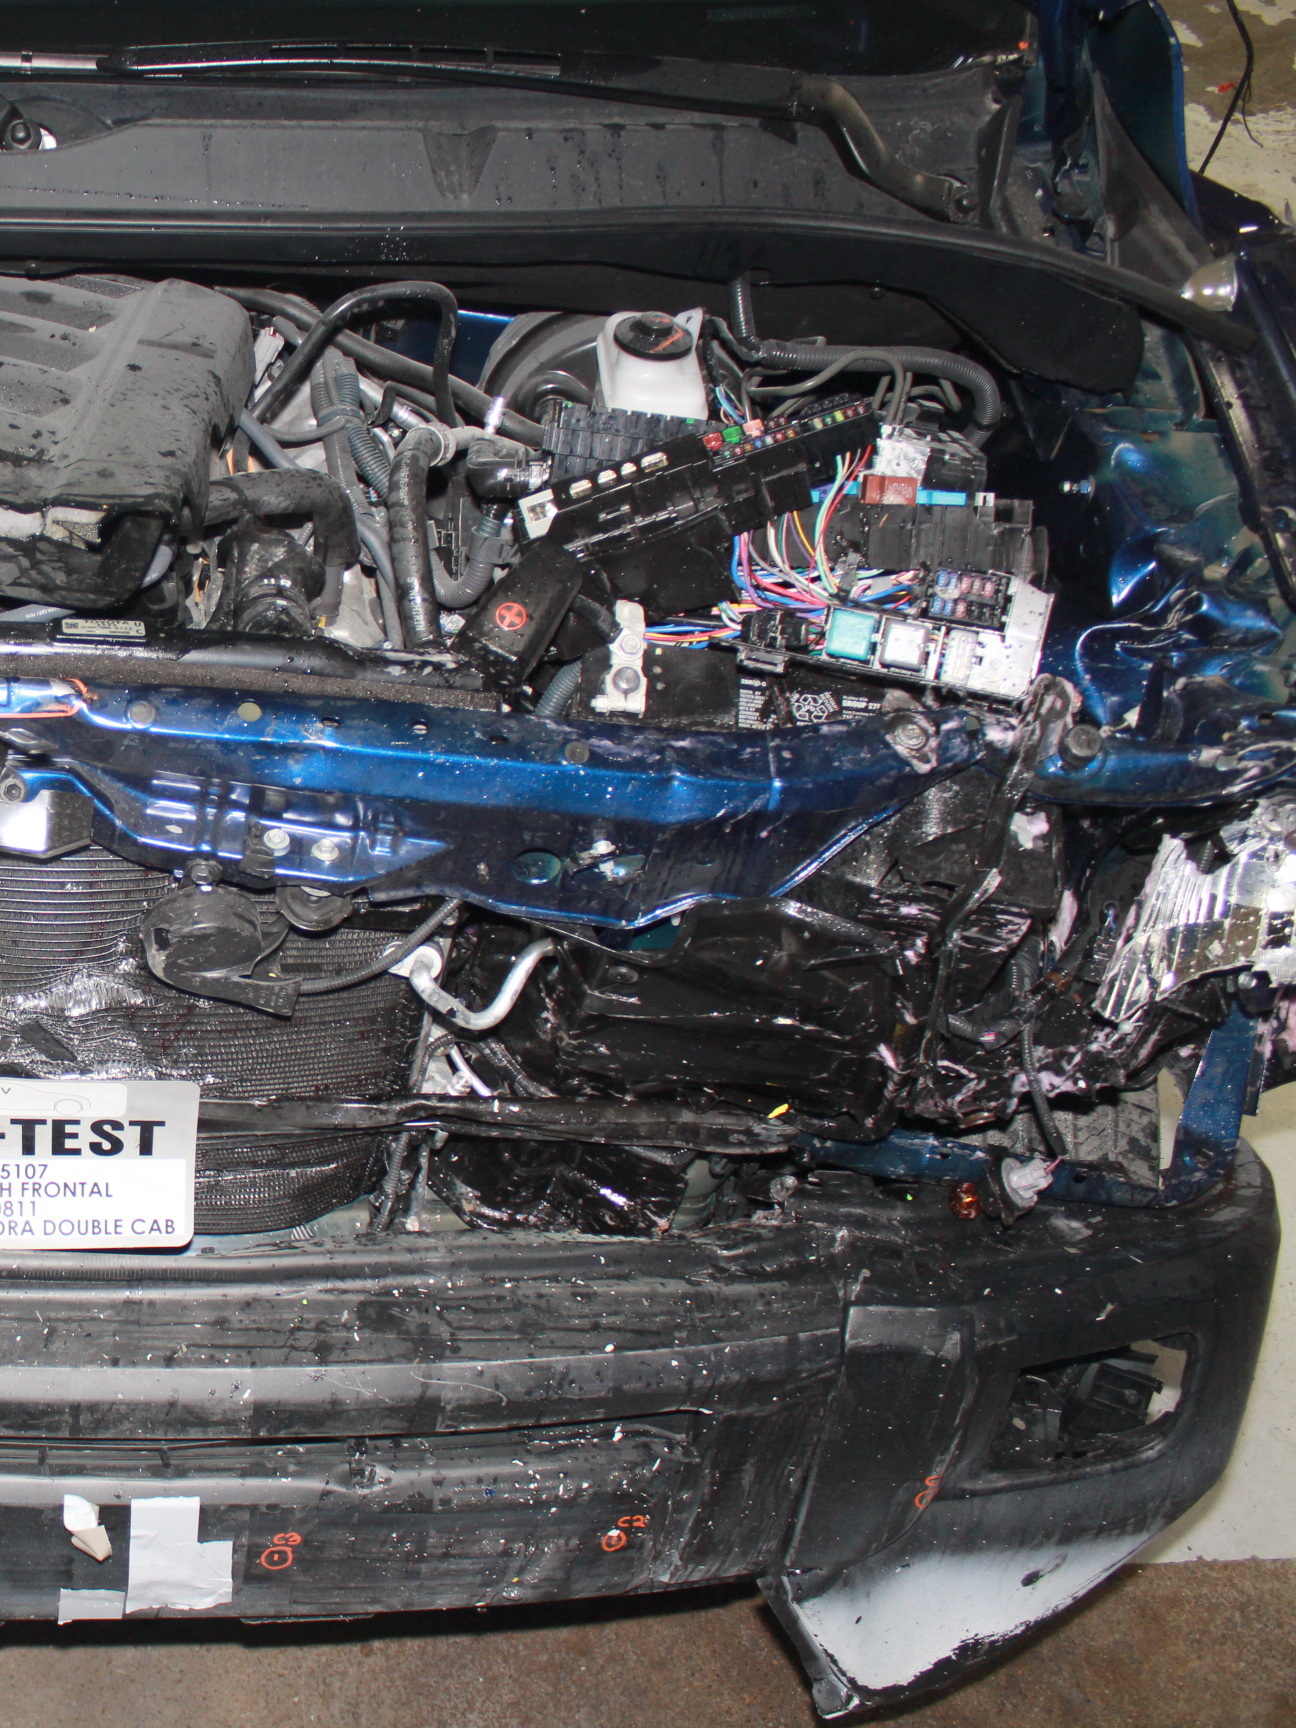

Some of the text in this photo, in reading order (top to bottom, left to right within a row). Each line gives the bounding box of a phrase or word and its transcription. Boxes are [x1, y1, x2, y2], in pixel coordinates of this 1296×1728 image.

[842, 700, 867, 708] GROUP
[21, 1181, 113, 1198] FRONTAL
[43, 1218, 124, 1236] DOUBLE
[131, 1218, 176, 1235] CAB
[617, 1514, 647, 1528] C2
[273, 1531, 303, 1546] C3
